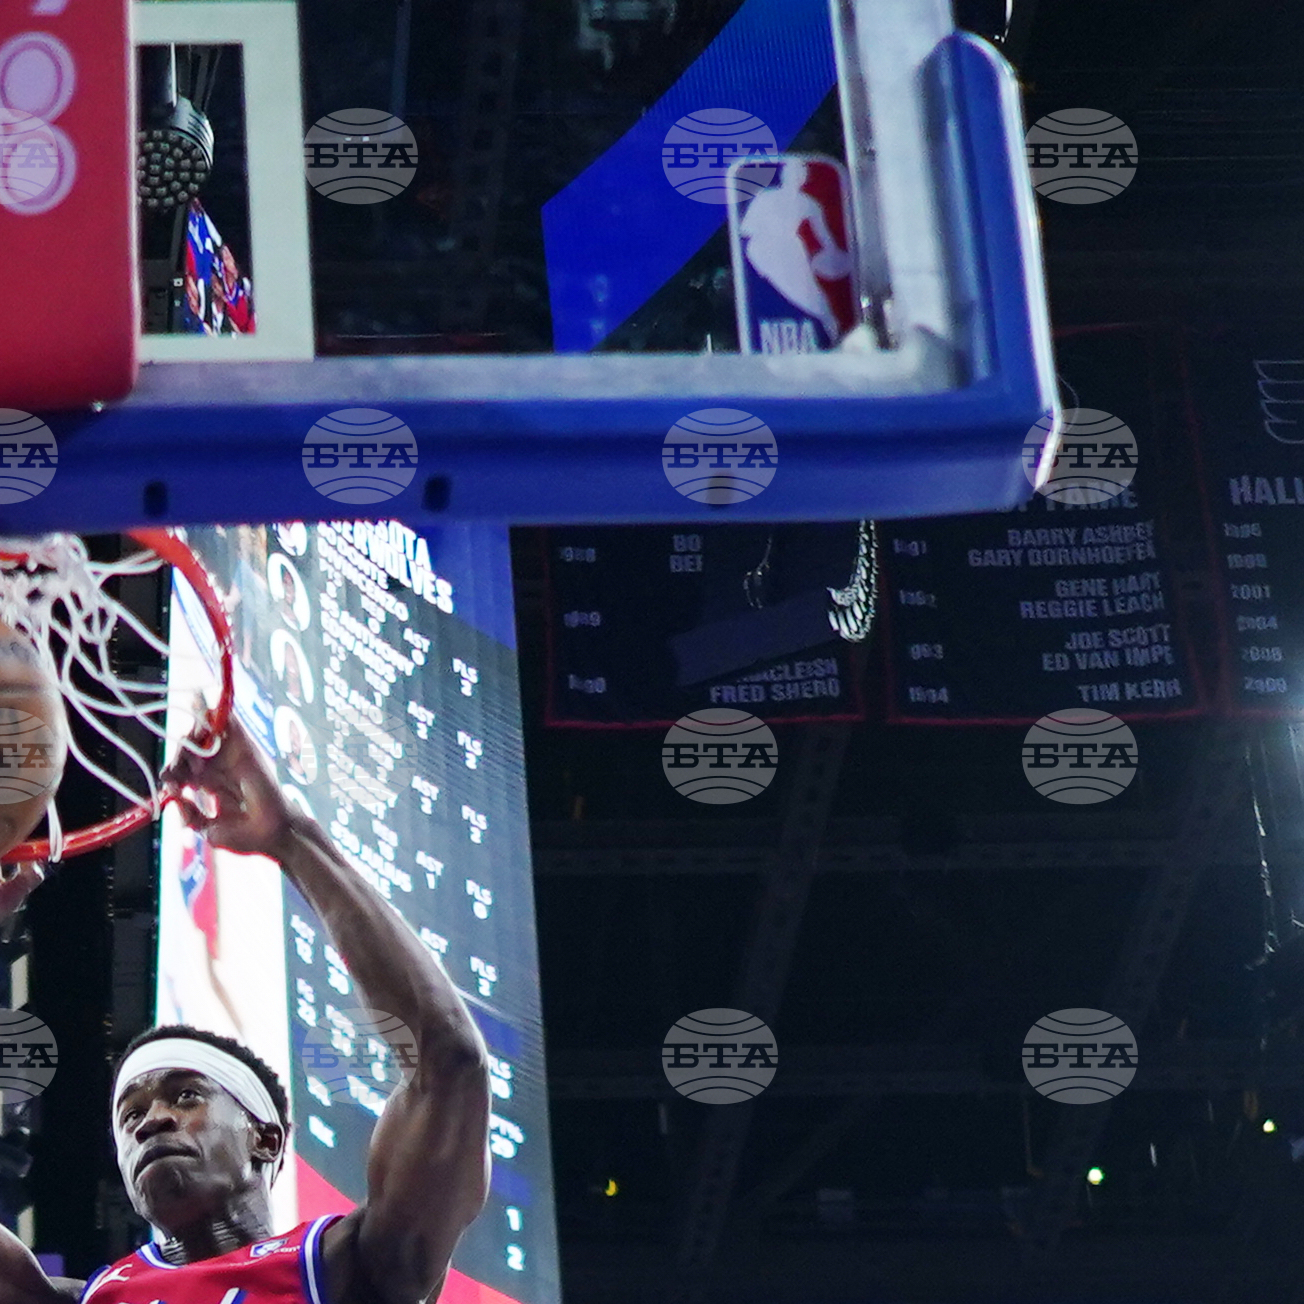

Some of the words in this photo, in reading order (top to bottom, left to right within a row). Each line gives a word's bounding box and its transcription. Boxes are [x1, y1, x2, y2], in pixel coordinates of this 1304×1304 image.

[760, 319, 816, 354] NBA
[1007, 527, 1077, 547] BARRY
[967, 548, 1024, 567] GARY
[1054, 577, 1109, 598] GENE
[1019, 598, 1098, 619] REGGIE
[1065, 631, 1105, 650] JOE
[1106, 622, 1171, 648] SCOTT
[403, 627, 431, 654] AST
[453, 658, 479, 684] FLS
[1041, 652, 1071, 672] ED
[1074, 648, 1119, 670] VAN
[709, 683, 765, 703] FRED
[1077, 681, 1120, 703] TIM
[407, 701, 436, 727] AST
[457, 731, 483, 756] FLS
[465, 751, 477, 770] 2
[411, 775, 440, 801] AST
[462, 804, 488, 831] FLS
[470, 826, 482, 844] 2
[415, 850, 445, 877] AST
[466, 879, 493, 906] FLS
[470, 956, 498, 982] FLS
[478, 977, 492, 997] 2
